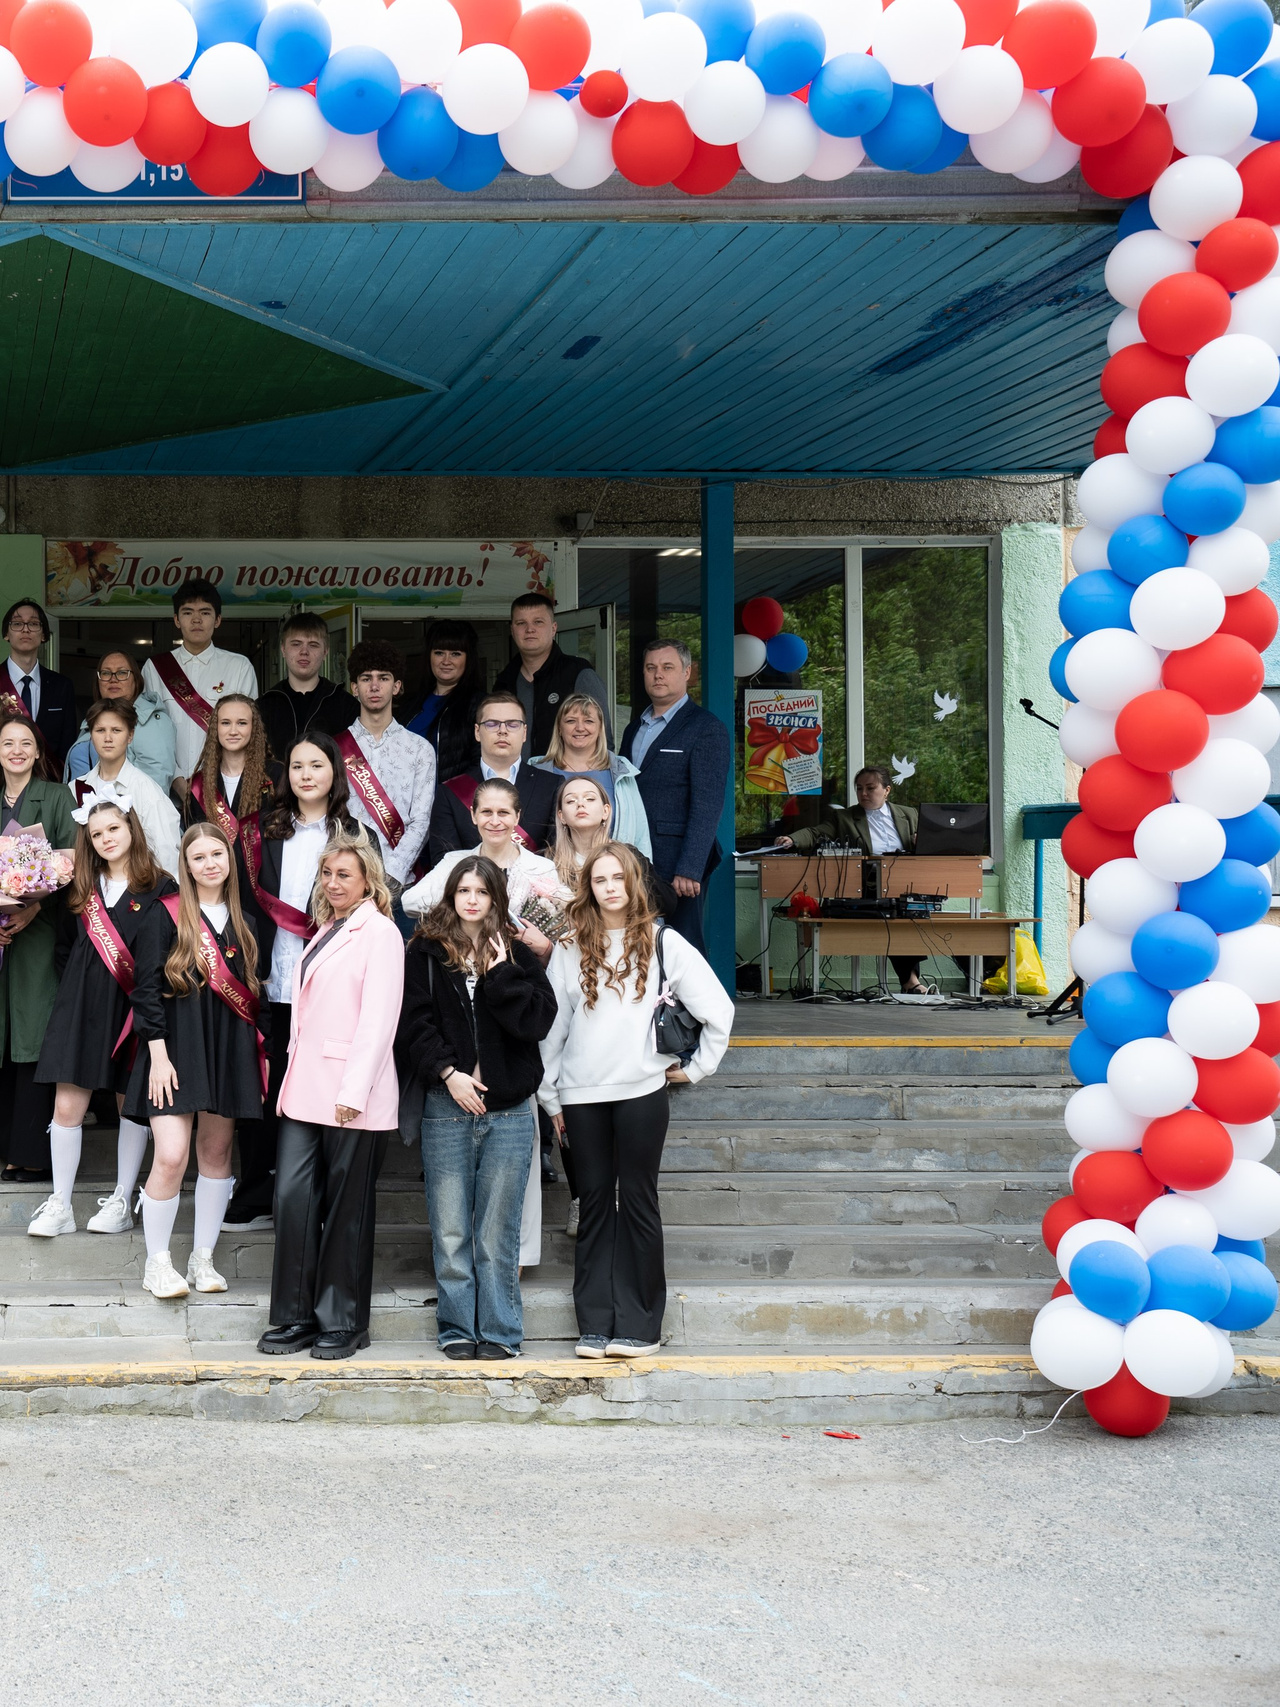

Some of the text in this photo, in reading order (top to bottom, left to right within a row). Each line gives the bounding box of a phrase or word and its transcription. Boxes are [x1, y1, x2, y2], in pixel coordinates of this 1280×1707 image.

[107, 556, 490, 594] Добро пожаловать!
[752, 697, 815, 715] ПОСЛЕДНИЙ
[767, 715, 817, 728] ЗВОНОК
